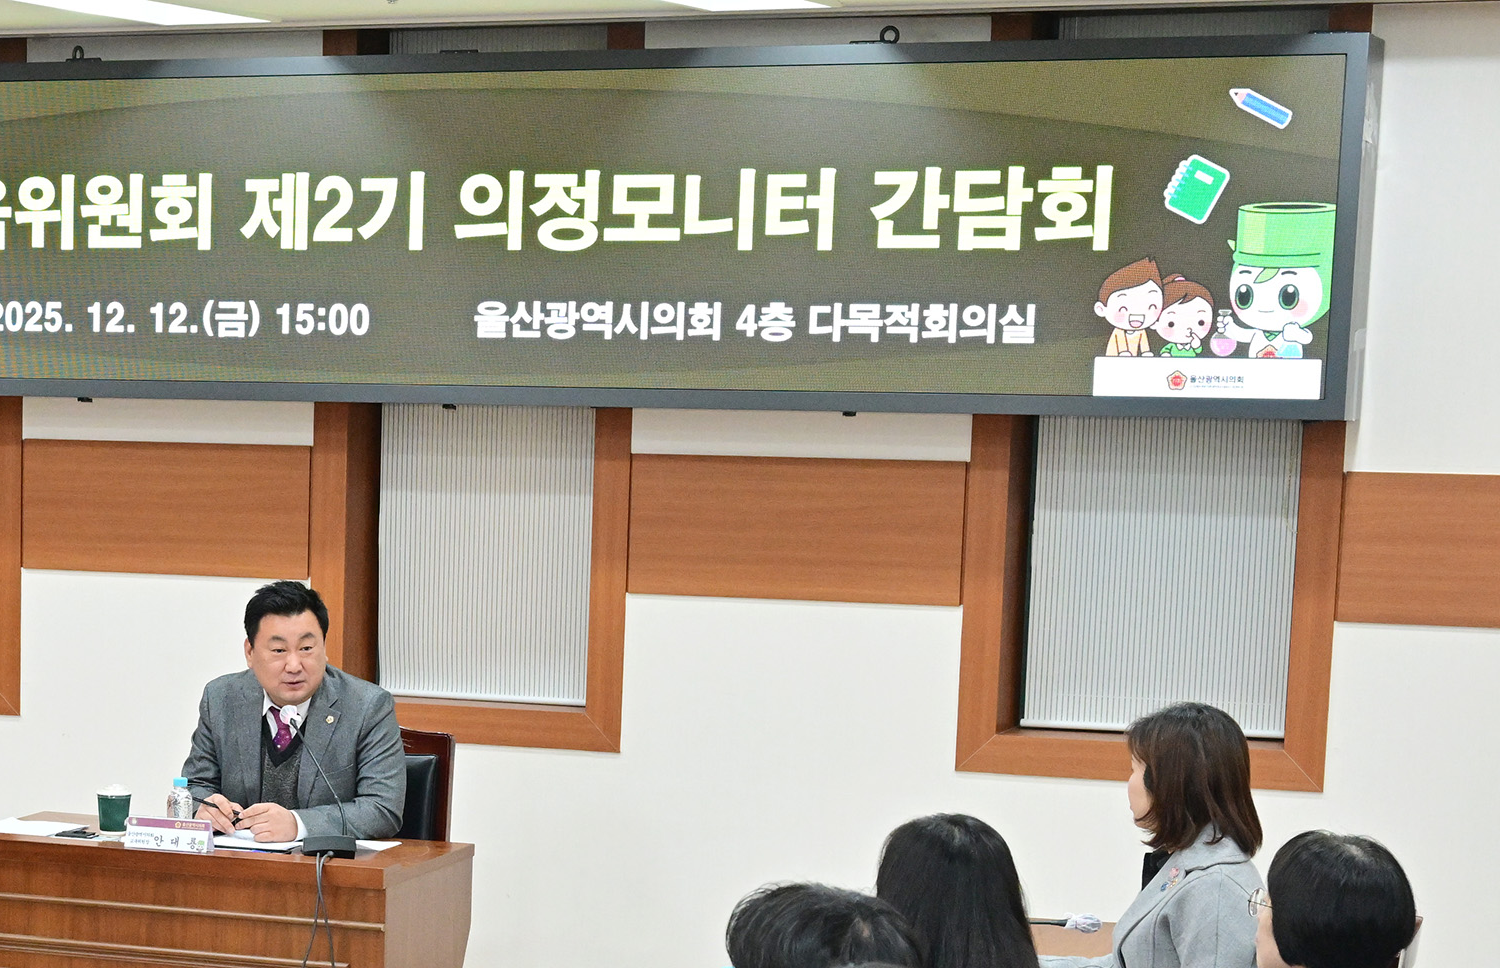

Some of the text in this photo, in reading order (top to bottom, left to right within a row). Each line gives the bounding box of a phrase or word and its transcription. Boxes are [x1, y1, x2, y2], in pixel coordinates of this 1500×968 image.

[240, 171, 425, 251] 제2기
[454, 167, 837, 252] 의정모니터
[870, 165, 1113, 251] 간담회
[87, 301, 136, 334] 12.
[150, 299, 261, 338] 12.(금)
[276, 302, 370, 336] 15:00
[473, 300, 1036, 344] 울산광역시의회 4층 다목적회의실
[1190, 374, 1245, 385] 울산광역시의회
